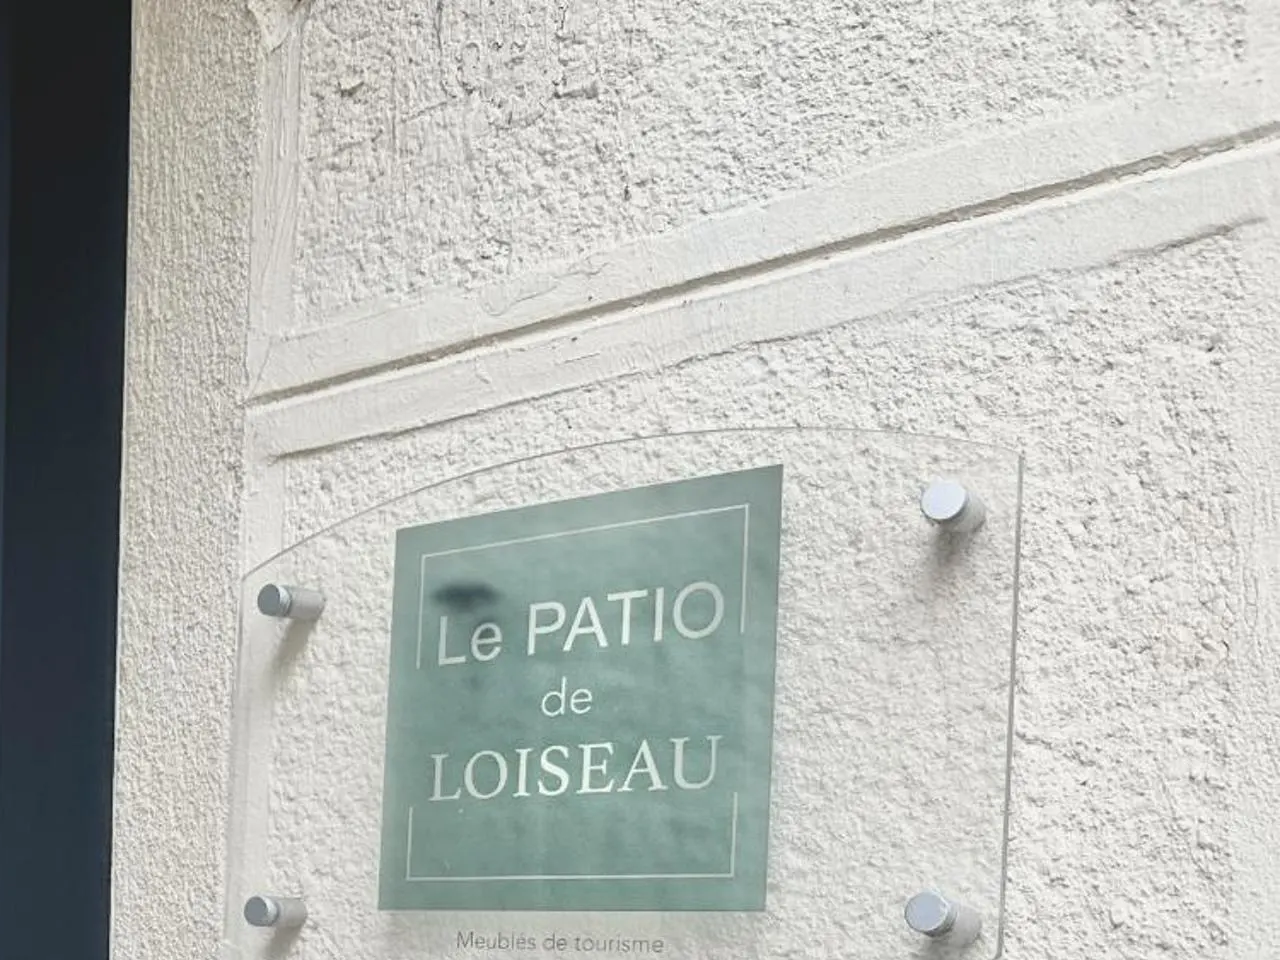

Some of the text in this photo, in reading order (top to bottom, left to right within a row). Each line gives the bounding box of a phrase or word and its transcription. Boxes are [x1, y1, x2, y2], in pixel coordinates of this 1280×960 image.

[437, 580, 725, 666] Le PATIO
[540, 675, 594, 718] de
[429, 734, 724, 802] LOISEAU
[456, 930, 665, 953] Meublés de tourisme
